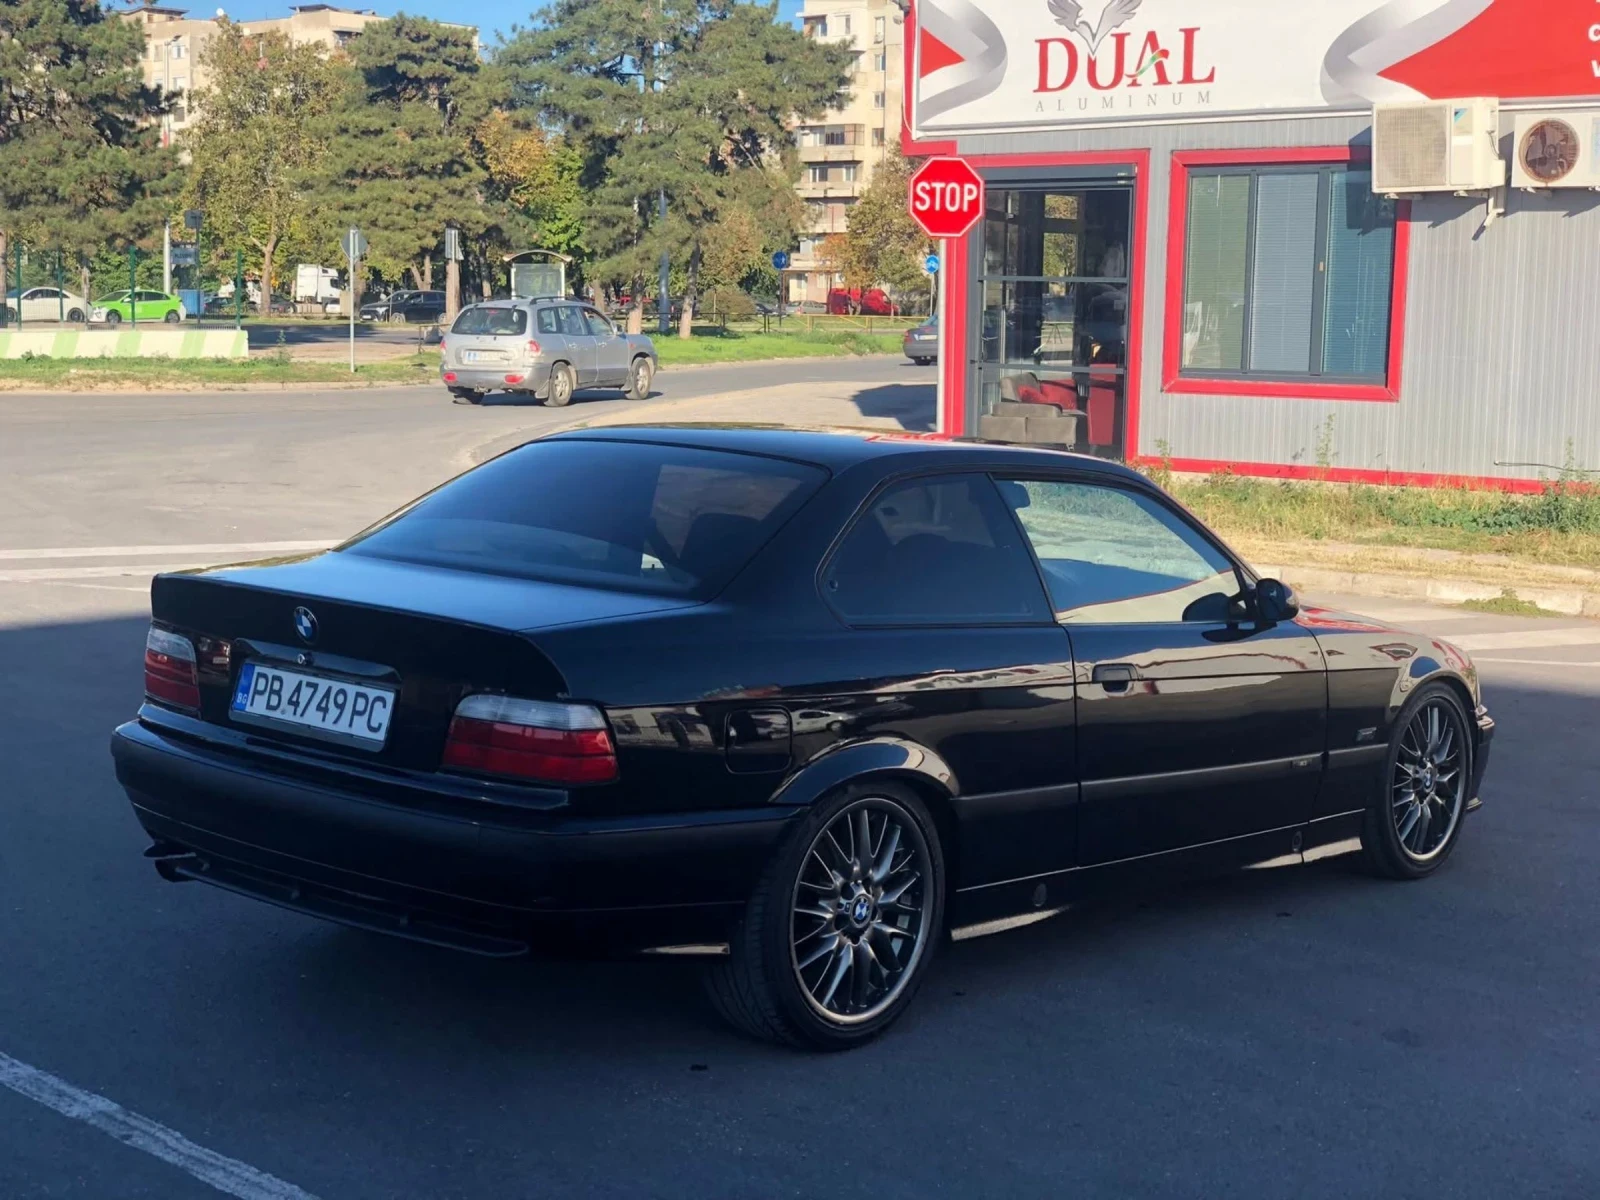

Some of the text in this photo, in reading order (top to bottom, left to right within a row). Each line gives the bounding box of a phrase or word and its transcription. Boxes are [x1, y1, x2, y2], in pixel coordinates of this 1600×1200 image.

[1033, 27, 1215, 92] DUAL
[1035, 91, 1212, 112] ALUMINUM
[915, 181, 978, 213] STOP
